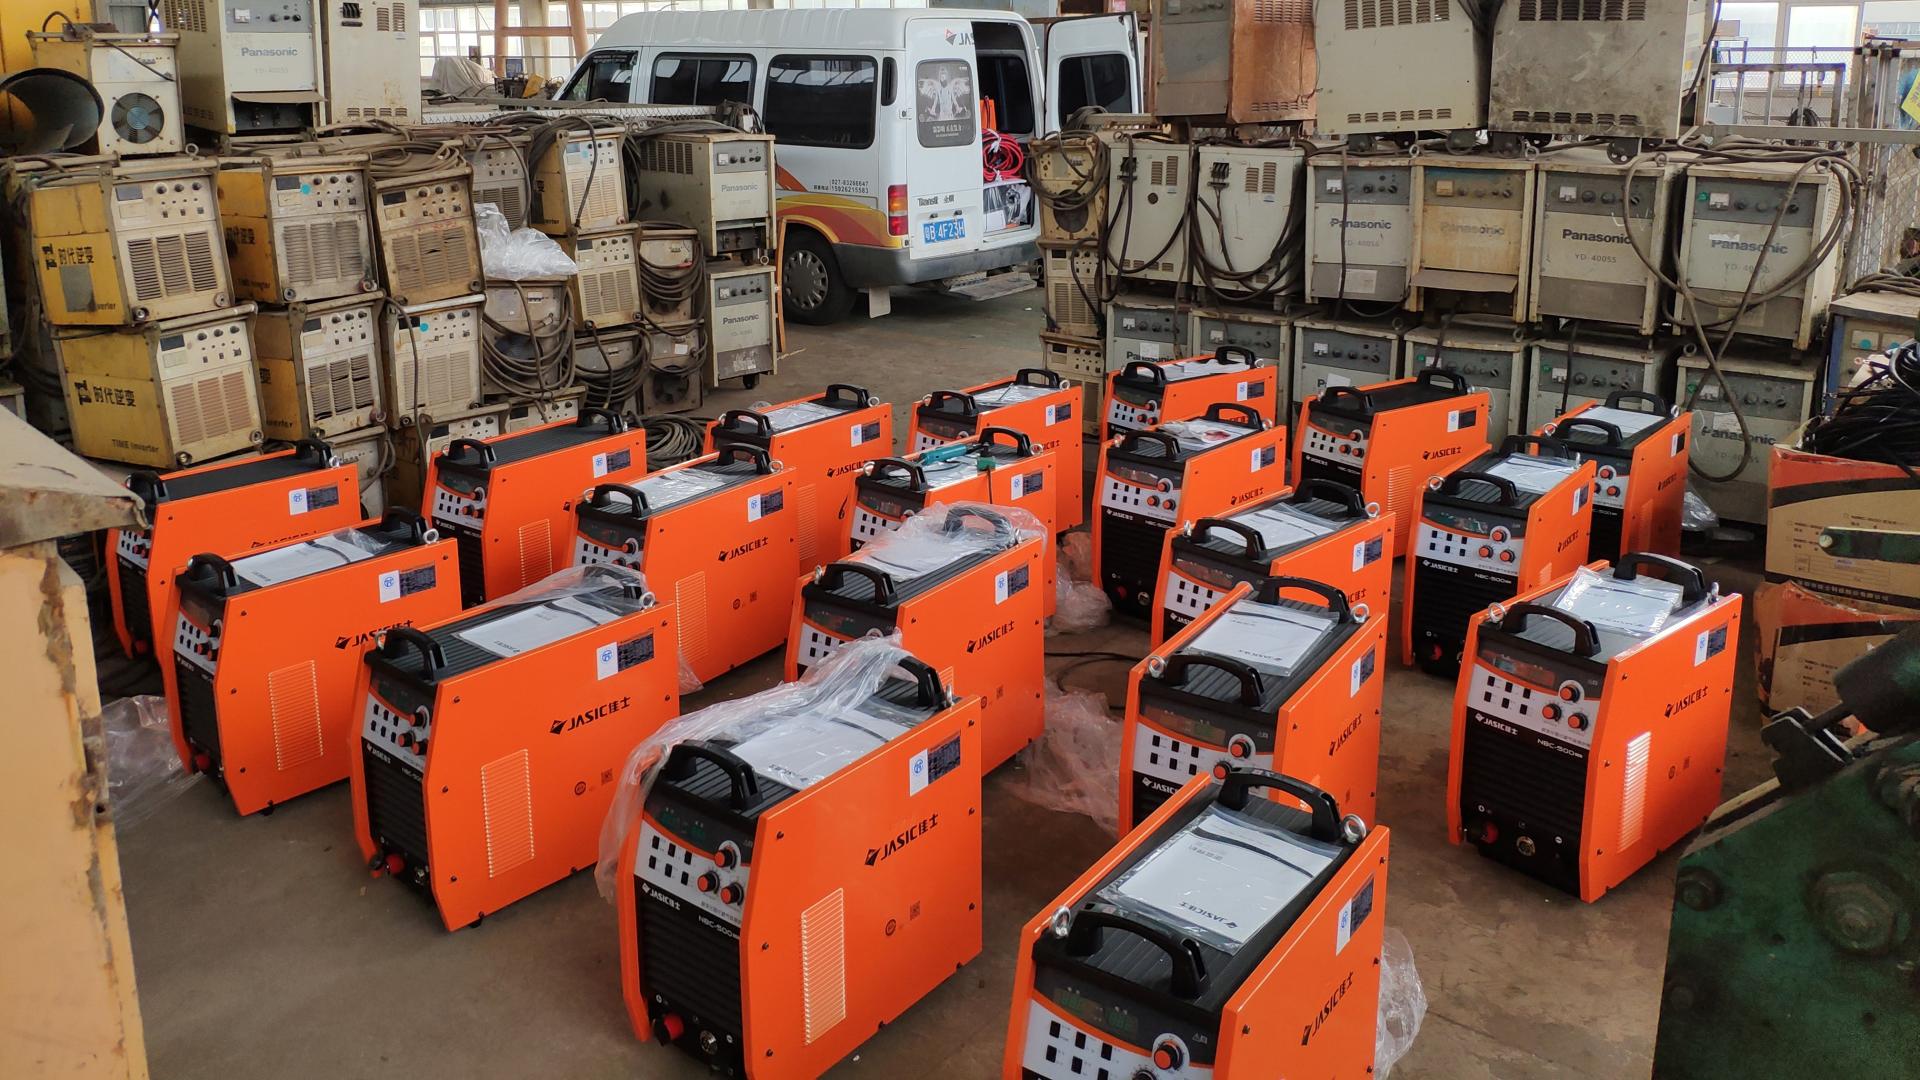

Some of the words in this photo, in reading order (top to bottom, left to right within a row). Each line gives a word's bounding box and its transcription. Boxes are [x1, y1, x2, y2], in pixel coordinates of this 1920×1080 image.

[241, 46, 298, 57] Panasonic
[721, 184, 758, 192] Panasonic
[1330, 217, 1392, 230] Pnasonic
[1562, 229, 1633, 245] Panasonic
[58, 245, 95, 265] 时代逆变
[722, 314, 759, 324] Panasonic
[93, 385, 136, 407] 时代逆变
